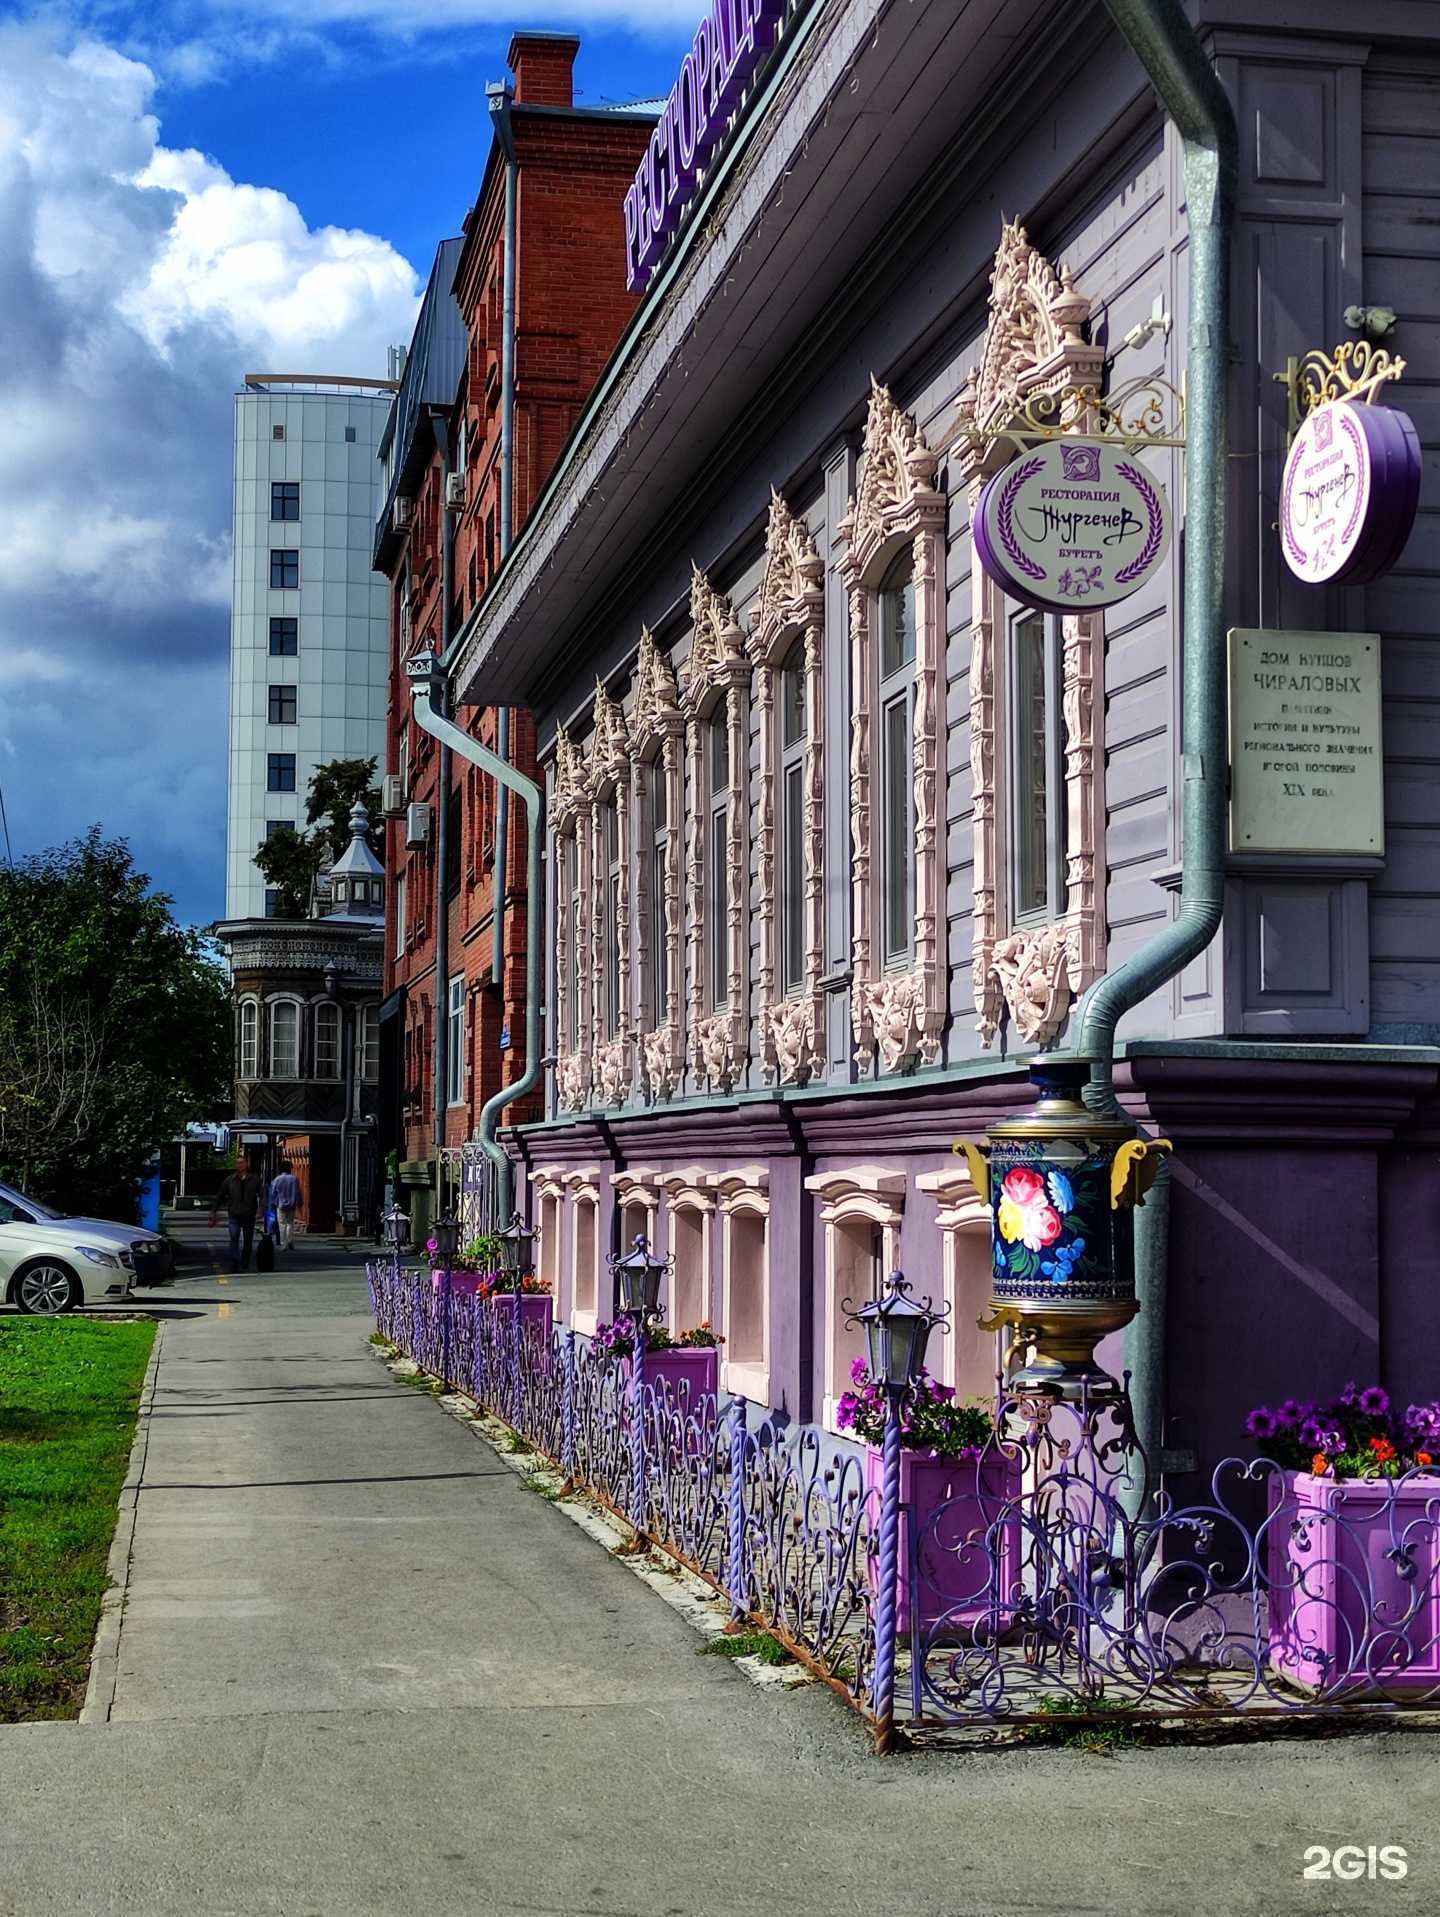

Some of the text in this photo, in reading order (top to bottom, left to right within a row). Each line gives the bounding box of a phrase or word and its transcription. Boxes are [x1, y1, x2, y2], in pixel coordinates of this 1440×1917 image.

[1040, 488, 1120, 502] РЕСТОРАЦИЯ
[1260, 651, 1289, 665] ДОМ
[1254, 673, 1361, 693] ЧИРАЛОВЫХ
